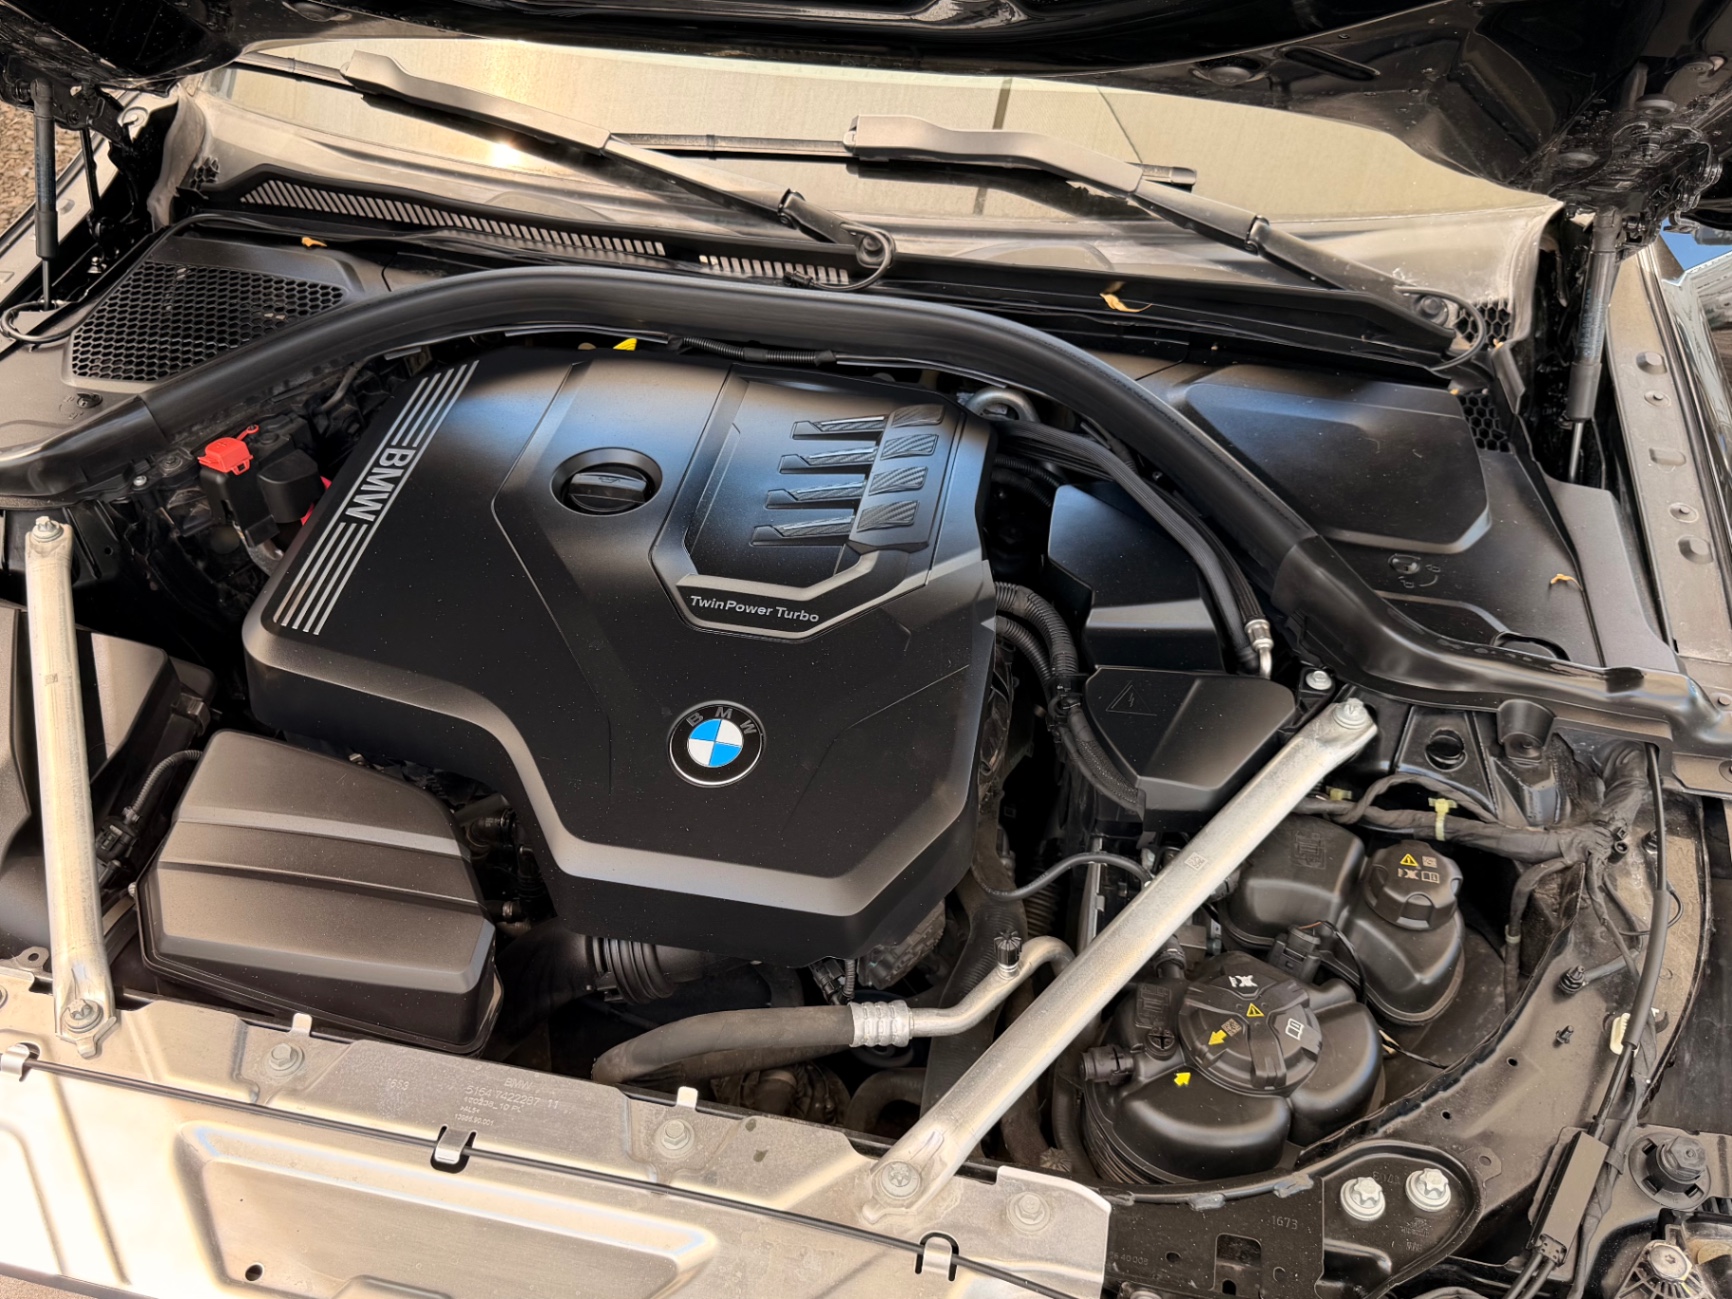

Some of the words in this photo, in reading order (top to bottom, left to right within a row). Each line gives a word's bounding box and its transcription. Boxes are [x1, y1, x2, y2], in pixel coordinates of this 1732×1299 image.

[345, 447, 417, 522] BMW
[775, 606, 820, 623] Turbo
[686, 706, 757, 736] BMW
[503, 1077, 533, 1091] BMW
[464, 1085, 492, 1099] 5164
[494, 1089, 541, 1106] 7422287
[1271, 1215, 1299, 1230] 1673
